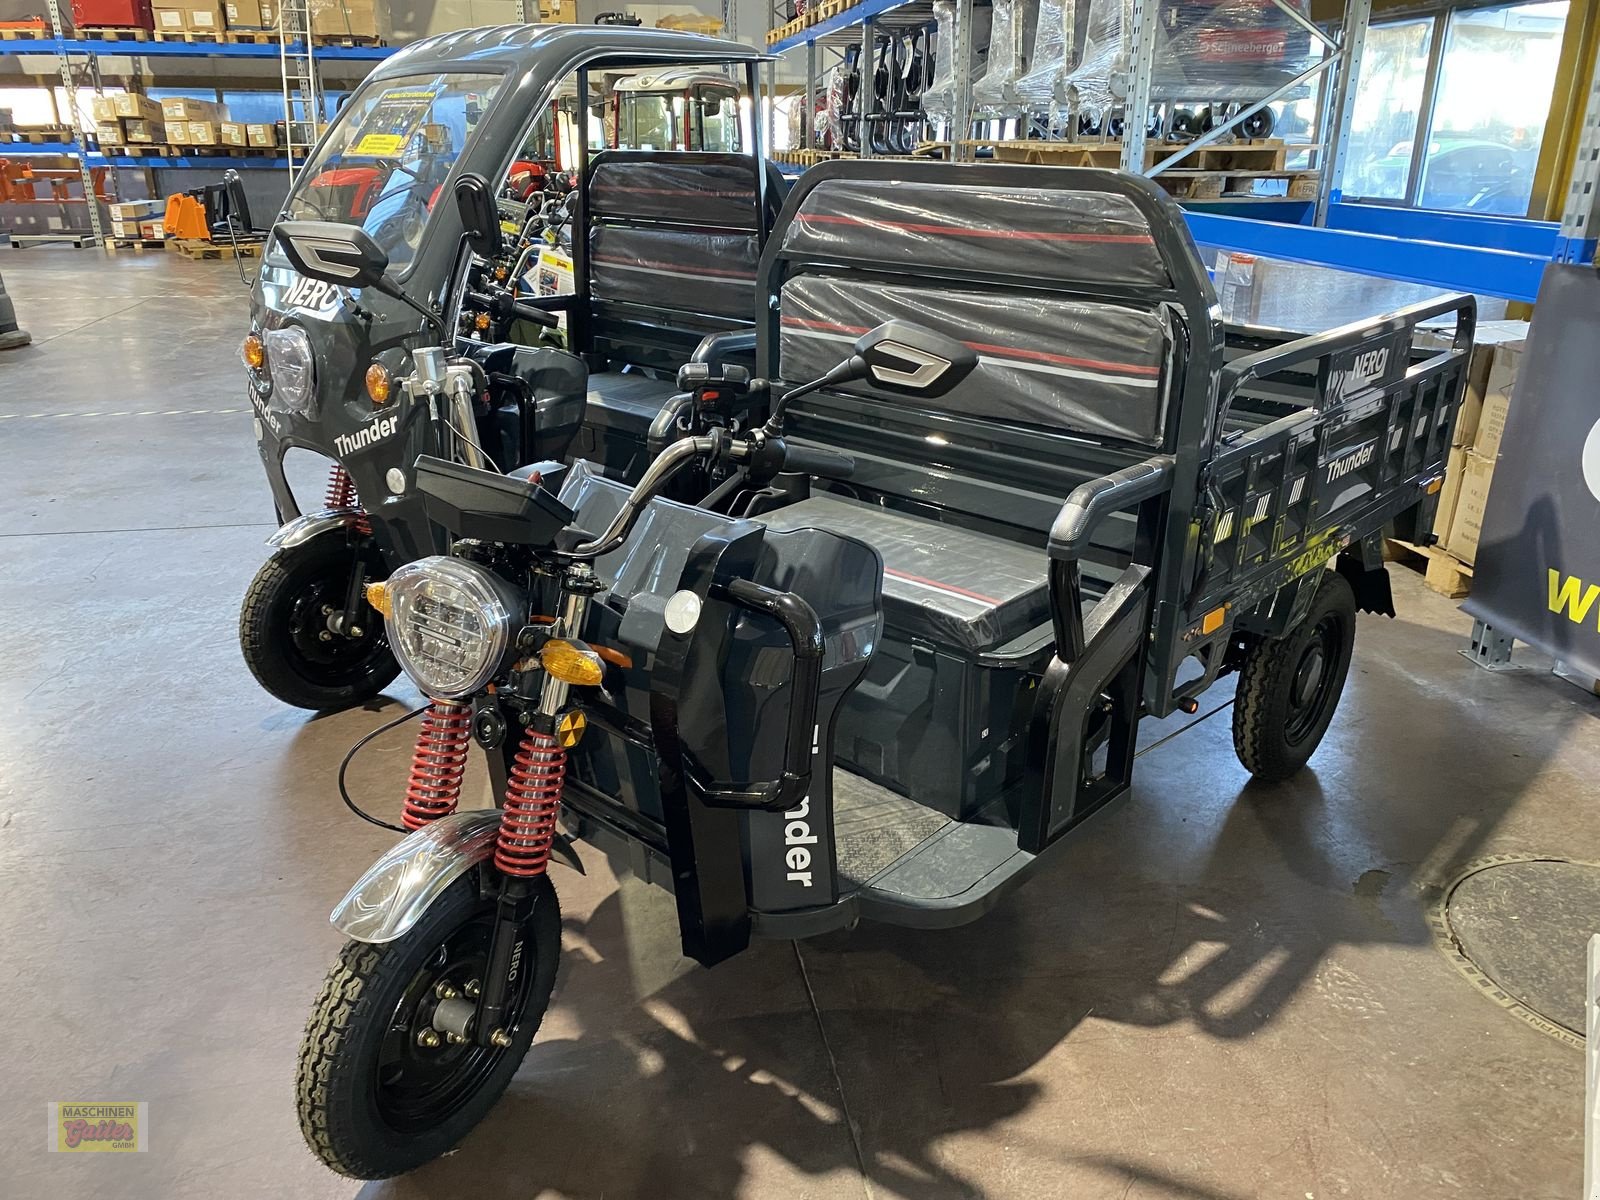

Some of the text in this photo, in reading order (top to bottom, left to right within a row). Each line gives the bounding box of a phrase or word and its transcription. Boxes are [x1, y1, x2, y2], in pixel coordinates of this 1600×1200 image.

[1351, 347, 1386, 380] NERO
[249, 380, 282, 434] hunder
[334, 415, 398, 458] Thunder
[1326, 444, 1375, 484] Thunder
[508, 940, 524, 981] NERO
